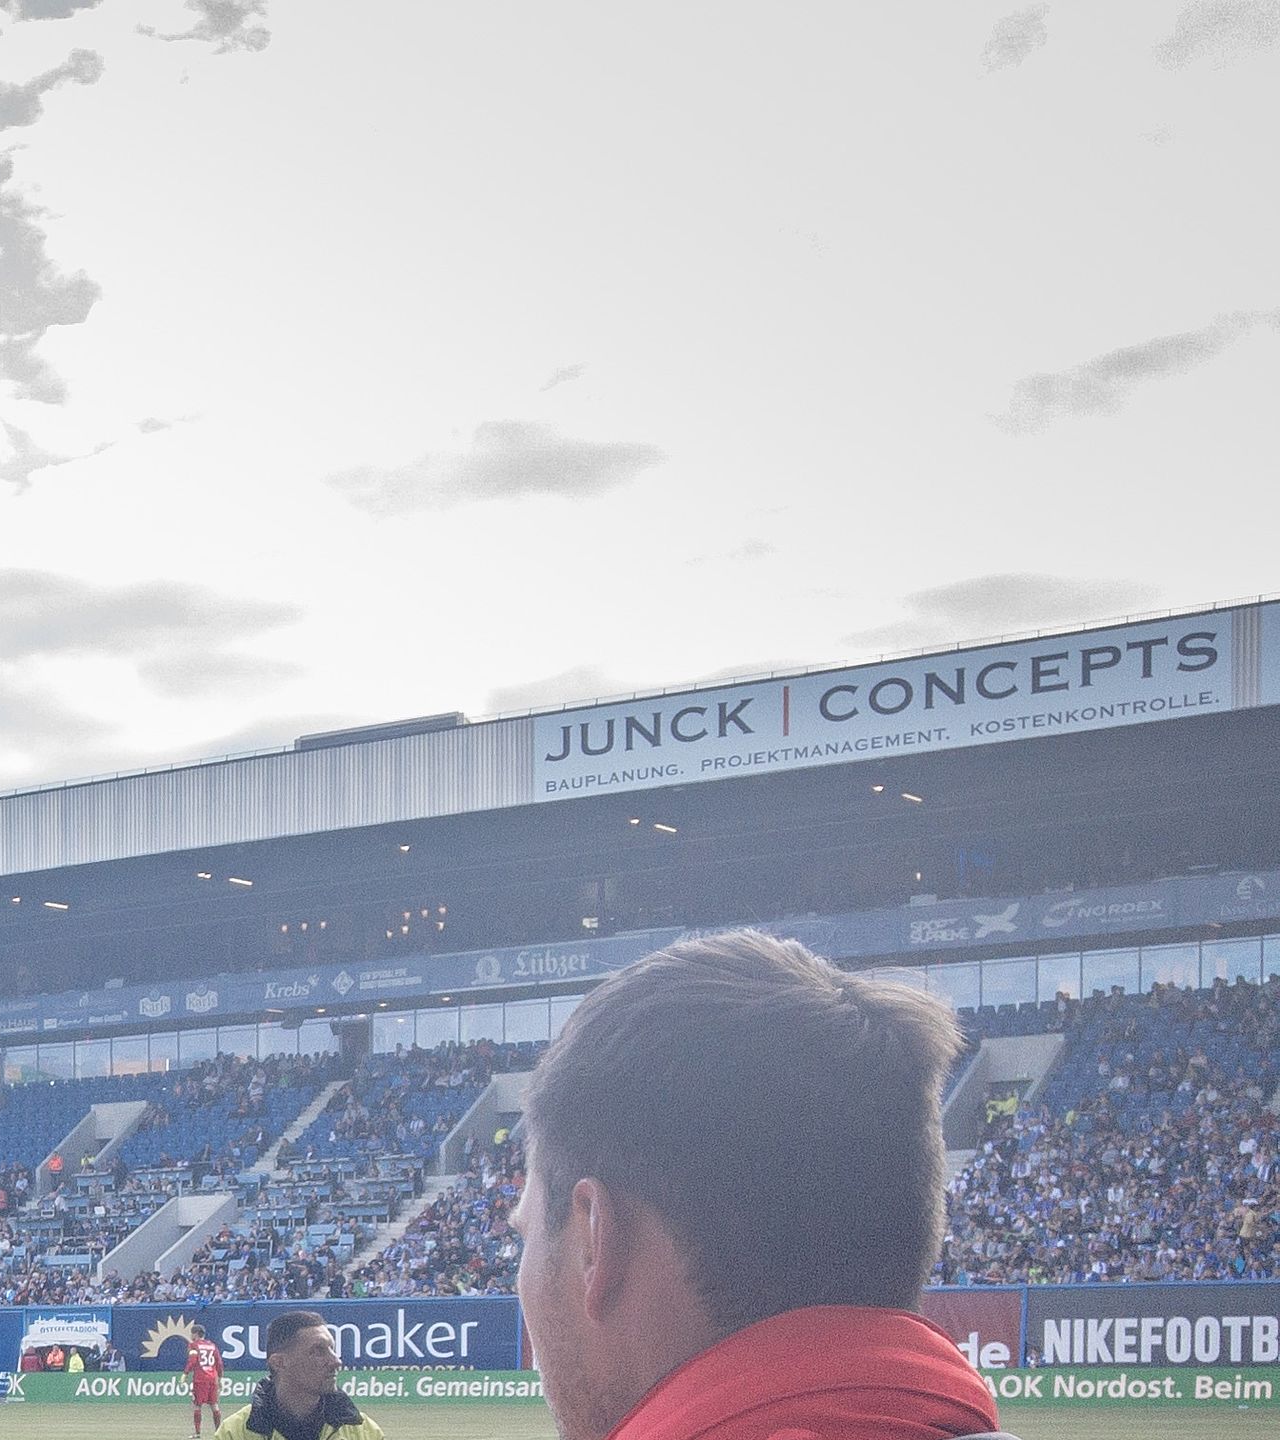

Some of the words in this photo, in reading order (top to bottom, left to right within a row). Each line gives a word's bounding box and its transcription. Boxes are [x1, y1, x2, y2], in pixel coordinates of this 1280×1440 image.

[544, 698, 755, 762] JUNCK
[819, 632, 1218, 722] CONCEPTS
[546, 764, 684, 793] BAUPLANUNG.
[701, 728, 950, 772] PROJEKTMANAGEMENT.
[970, 691, 1220, 737] KOSTENKONTROLLE.
[1079, 899, 1164, 918] NORDEX
[513, 950, 590, 977] Lübzer
[264, 980, 310, 999] Krebs
[222, 1309, 478, 1359] sumaker
[1043, 1316, 1280, 1363] NIKEFOOTB
[199, 1349, 215, 1366] 36
[75, 1377, 121, 1397] AOK
[220, 1376, 258, 1396] Bei
[342, 1376, 408, 1397] dabei.
[1053, 1373, 1182, 1399] Nordost.
[1194, 1374, 1273, 1399] Beim
